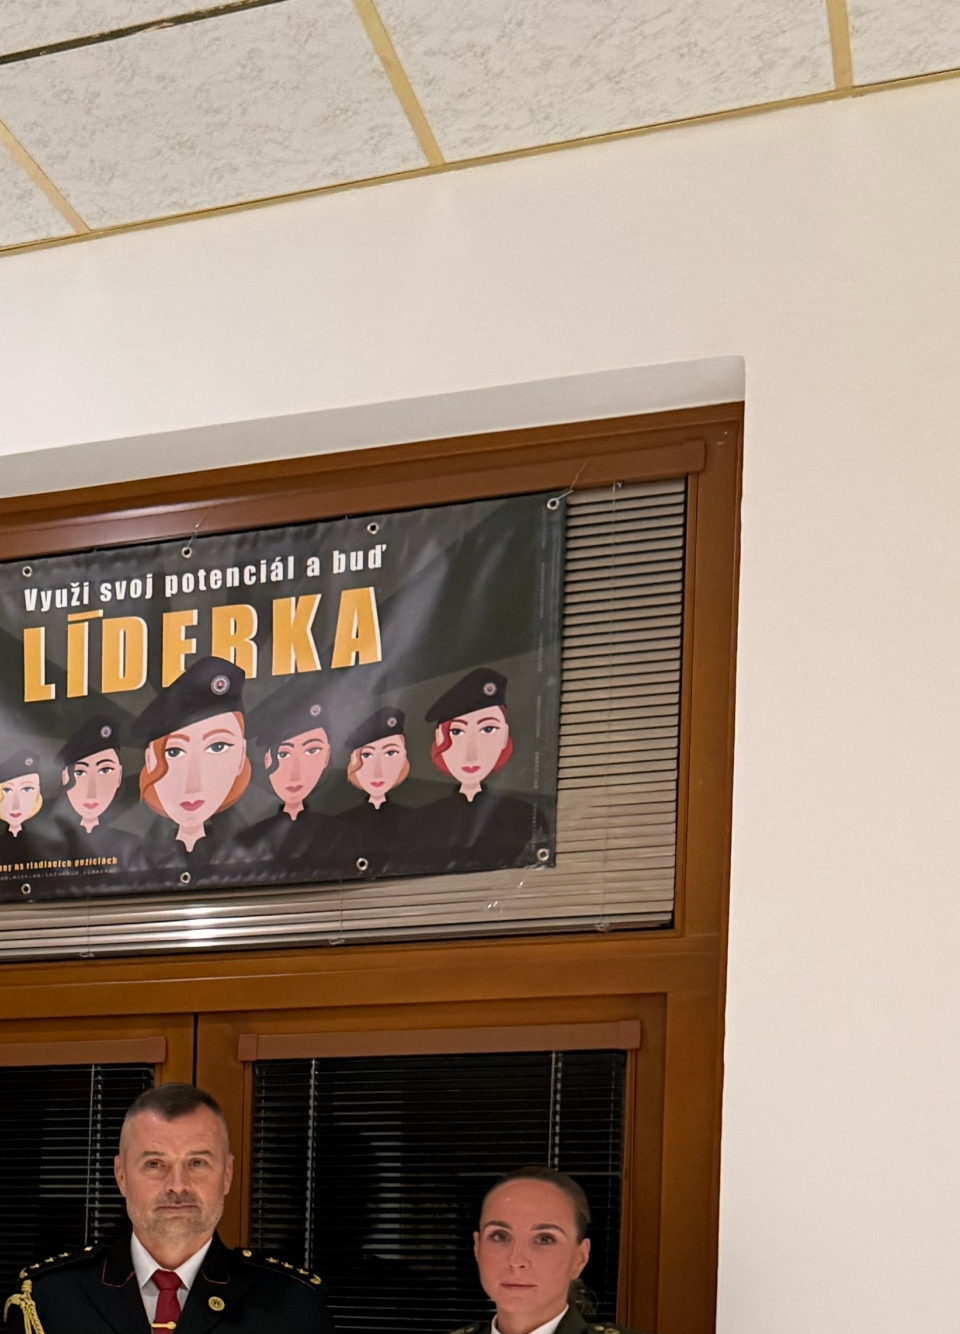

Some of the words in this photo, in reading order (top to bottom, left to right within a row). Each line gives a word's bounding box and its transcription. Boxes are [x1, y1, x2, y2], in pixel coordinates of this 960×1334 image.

[24, 582, 90, 612] Využi
[99, 574, 153, 602] svoj
[164, 555, 295, 598] potenciál
[306, 556, 321, 577] a
[332, 544, 387, 574] buď
[23, 586, 383, 703] LÍDERKA
